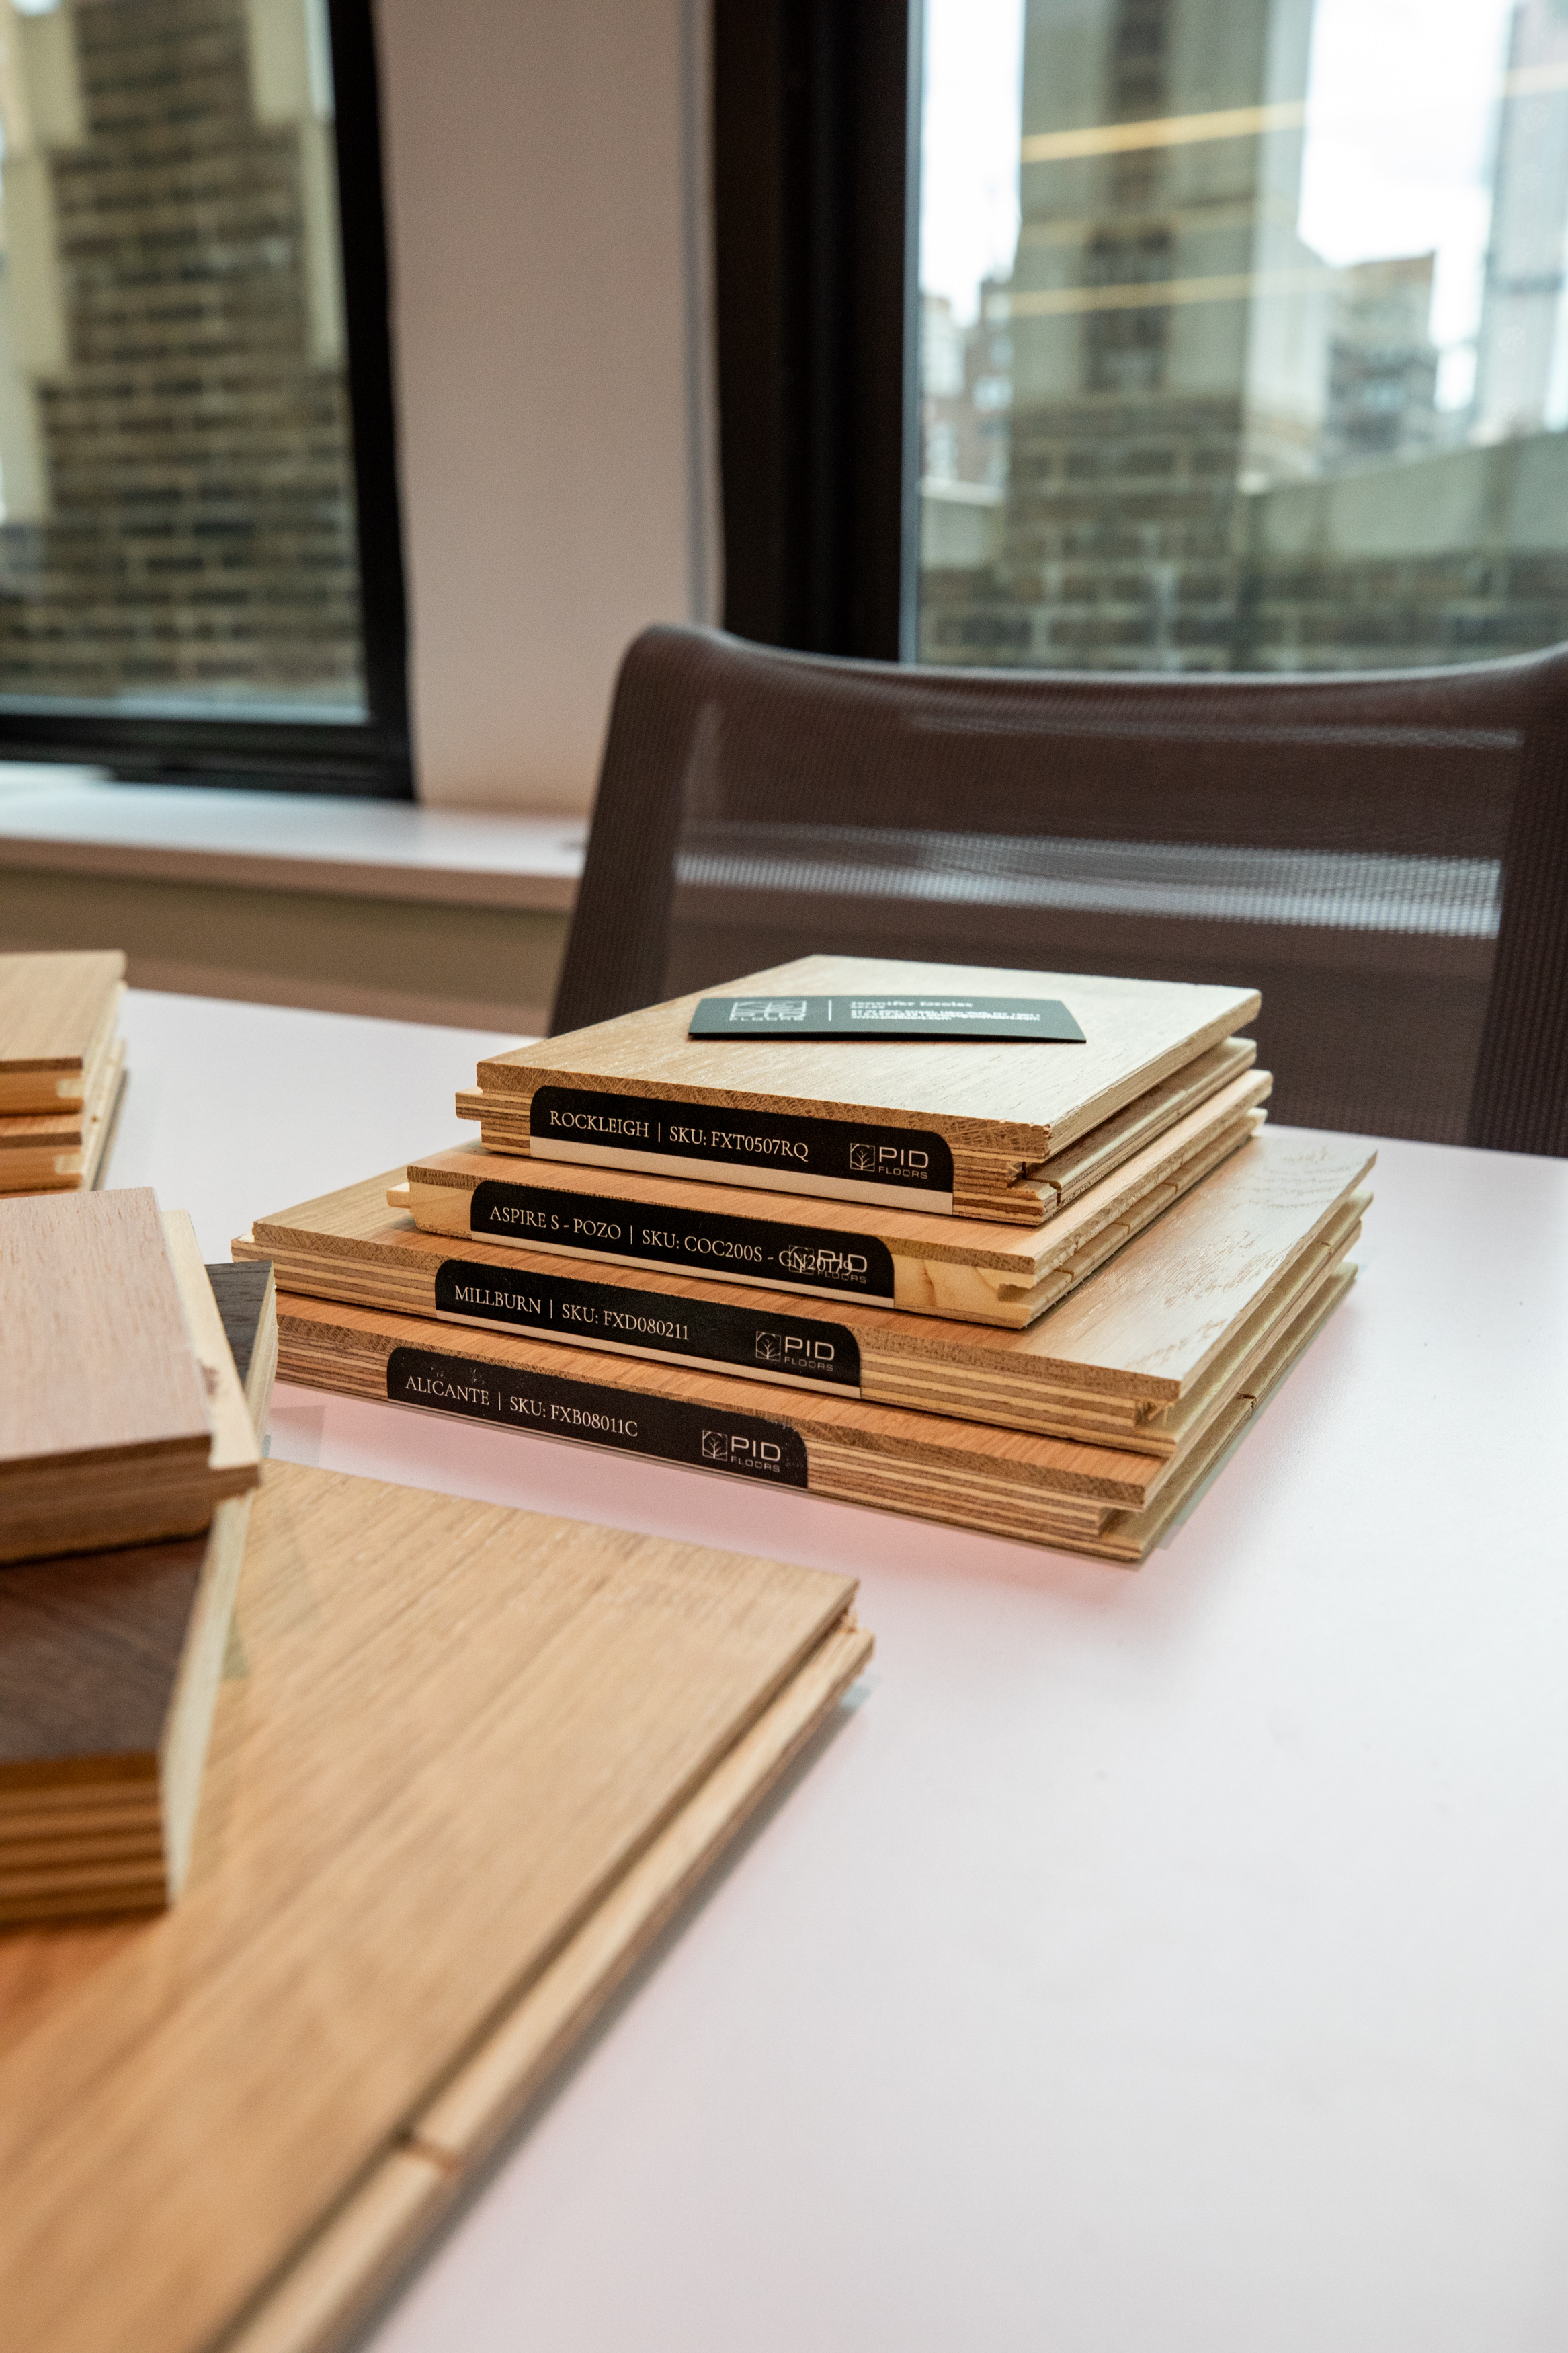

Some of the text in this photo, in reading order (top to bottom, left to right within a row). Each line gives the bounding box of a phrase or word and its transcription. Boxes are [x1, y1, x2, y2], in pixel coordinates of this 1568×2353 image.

[550, 1110, 649, 1138] ROCKLEIGH
[669, 1125, 708, 1146] SKU:
[711, 1131, 809, 1162] FXT0507RQ
[878, 1146, 929, 1168] PID
[878, 1166, 927, 1179] FLOORS
[489, 1206, 546, 1228] ASPIRE
[550, 1214, 559, 1230] S
[573, 1218, 622, 1240] POZO
[642, 1229, 680, 1250] SKU:
[684, 1236, 763, 1262] COC200S
[817, 1249, 868, 1273] PID
[817, 1270, 867, 1285] FLOORS
[455, 1285, 541, 1314] MILLBURN
[562, 1303, 599, 1324] SKU:
[603, 1310, 689, 1341] FXD080211
[784, 1335, 835, 1361] PID
[784, 1356, 833, 1372] FLOORS
[405, 1375, 490, 1406] ALICANTE
[510, 1396, 546, 1418] SKU:
[550, 1404, 638, 1437] FXB08011C
[731, 1435, 781, 1462] PID
[730, 1455, 780, 1472] FLOORS
